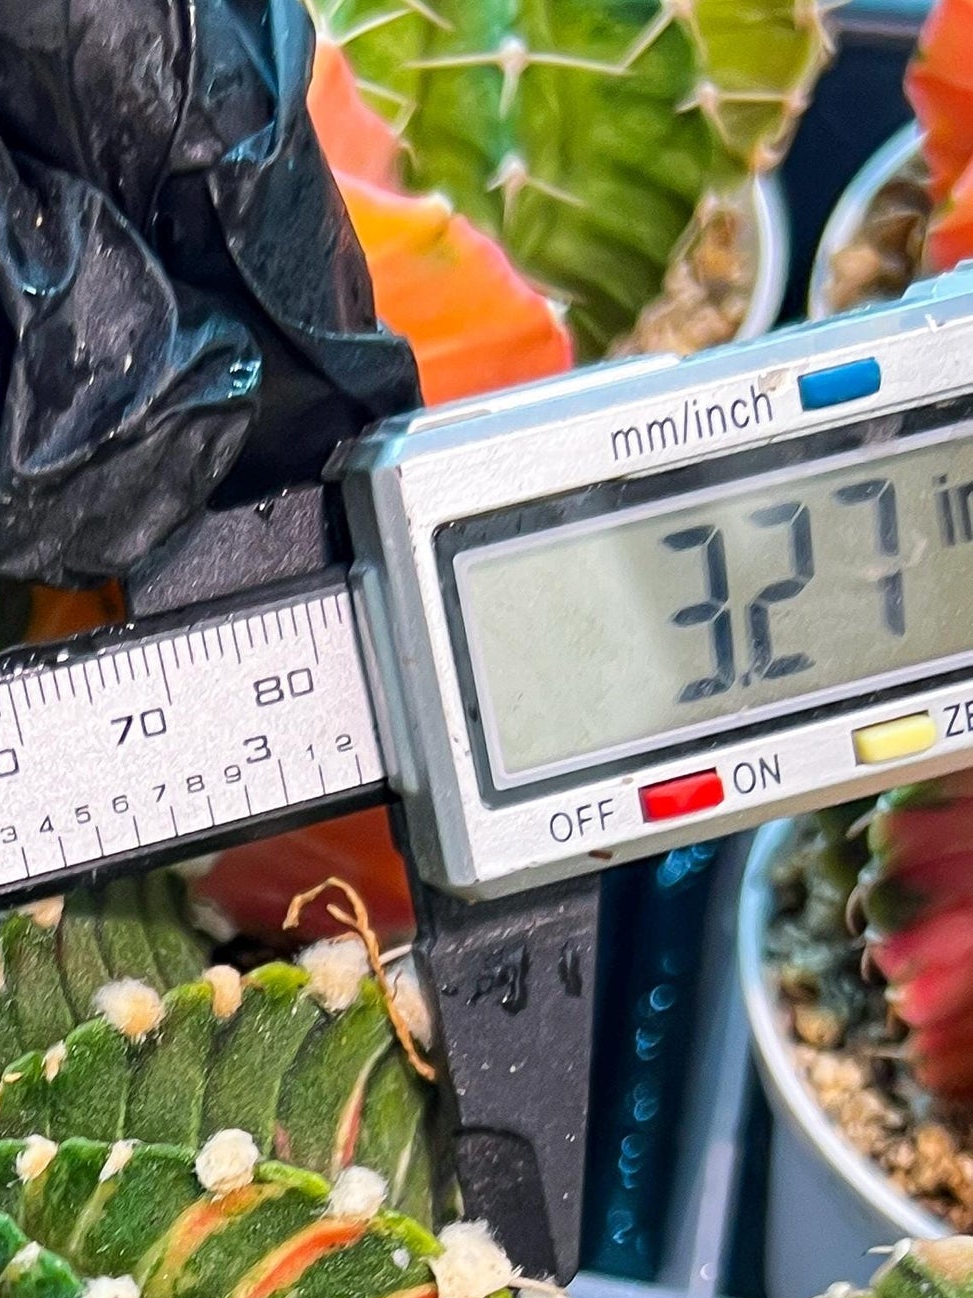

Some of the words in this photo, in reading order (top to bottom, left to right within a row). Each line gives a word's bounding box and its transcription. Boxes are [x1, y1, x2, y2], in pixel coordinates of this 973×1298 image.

[609, 384, 775, 462] mm/inch
[110, 706, 168, 747] 70
[252, 667, 315, 708] 80
[0, 825, 18, 844] 3
[39, 814, 55, 834] 4
[74, 804, 92, 825] 5
[111, 794, 130, 815] 6
[152, 783, 166, 803] 7
[185, 774, 206, 794] 8
[223, 764, 242, 785] 9
[242, 734, 272, 765] 3
[305, 743, 315, 761] 1
[334, 733, 354, 753] 2
[548, 800, 617, 843] OFF
[732, 754, 783, 795] ON
